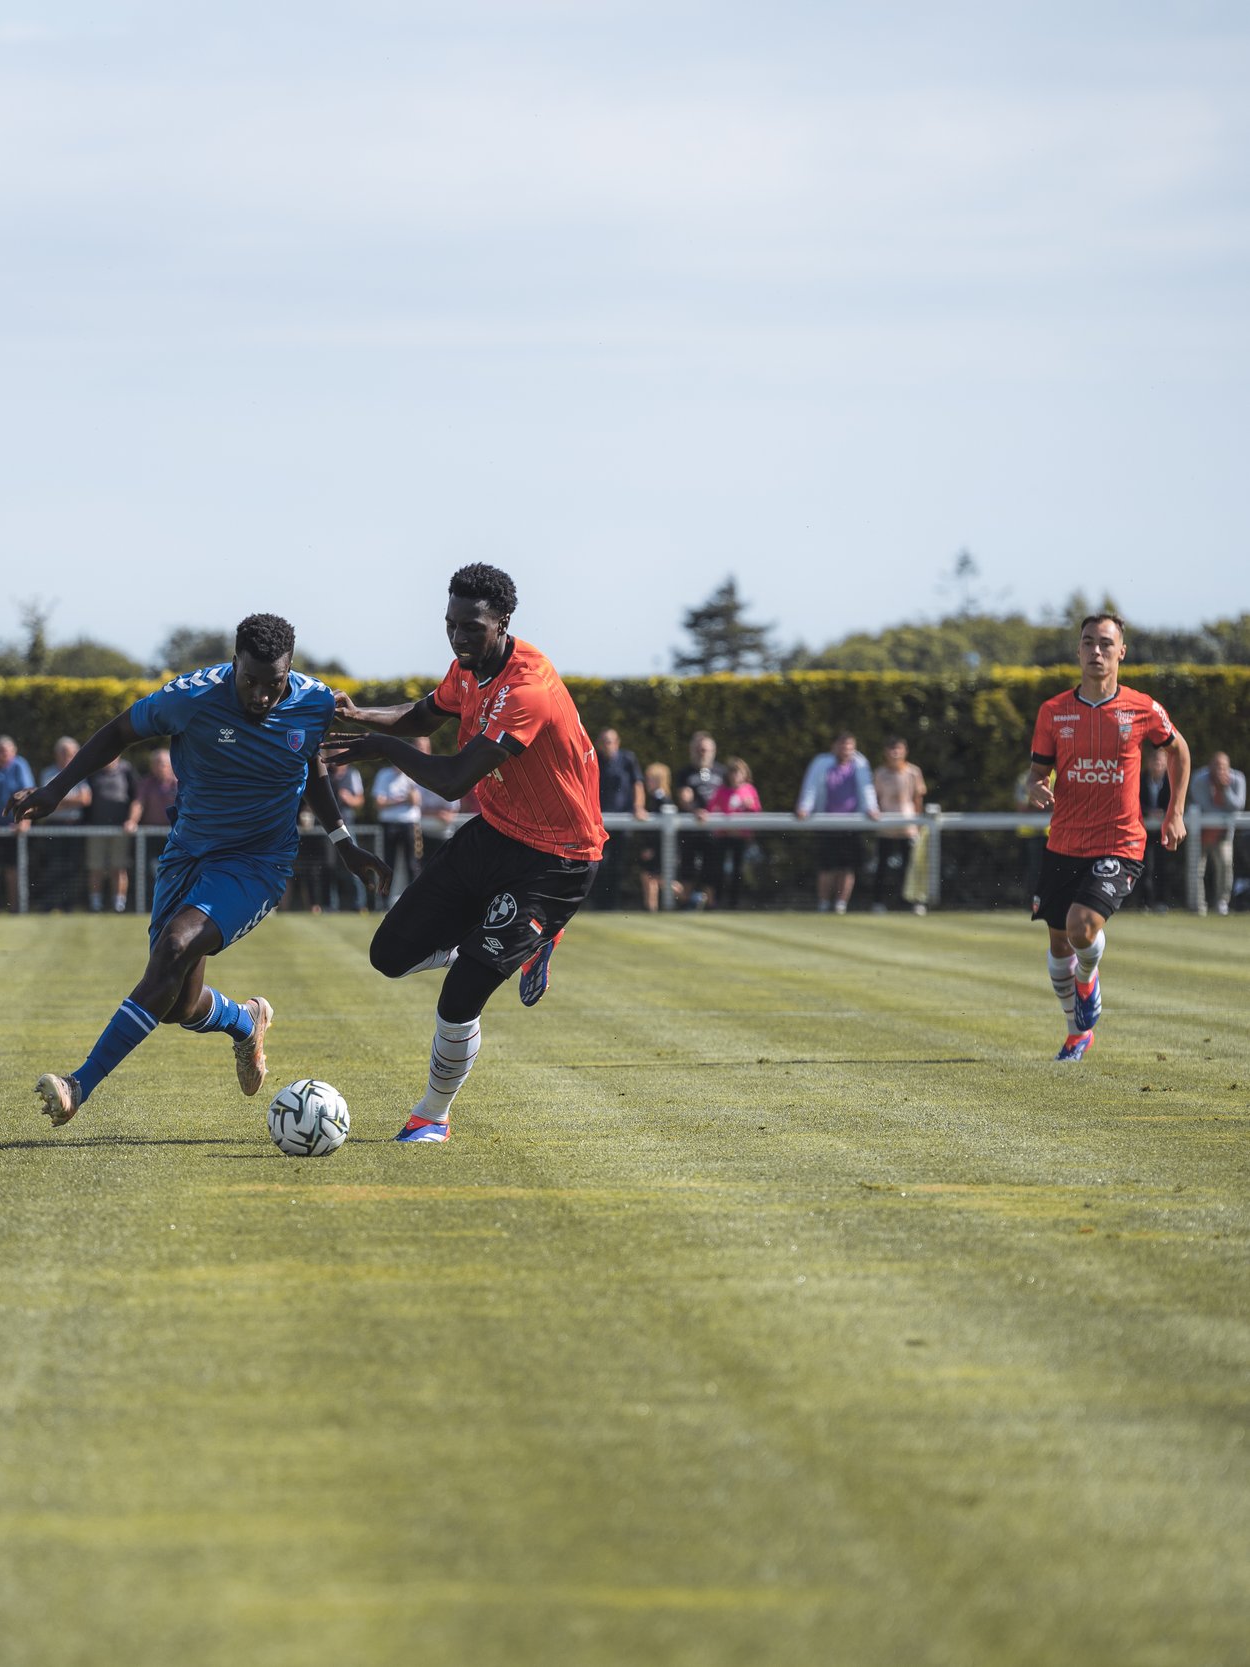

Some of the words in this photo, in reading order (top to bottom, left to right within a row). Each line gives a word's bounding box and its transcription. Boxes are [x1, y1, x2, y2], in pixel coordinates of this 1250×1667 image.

[1073, 757, 1118, 771] JEAN
[1067, 769, 1124, 784] FLOC'H
[481, 943, 499, 956] umbro
